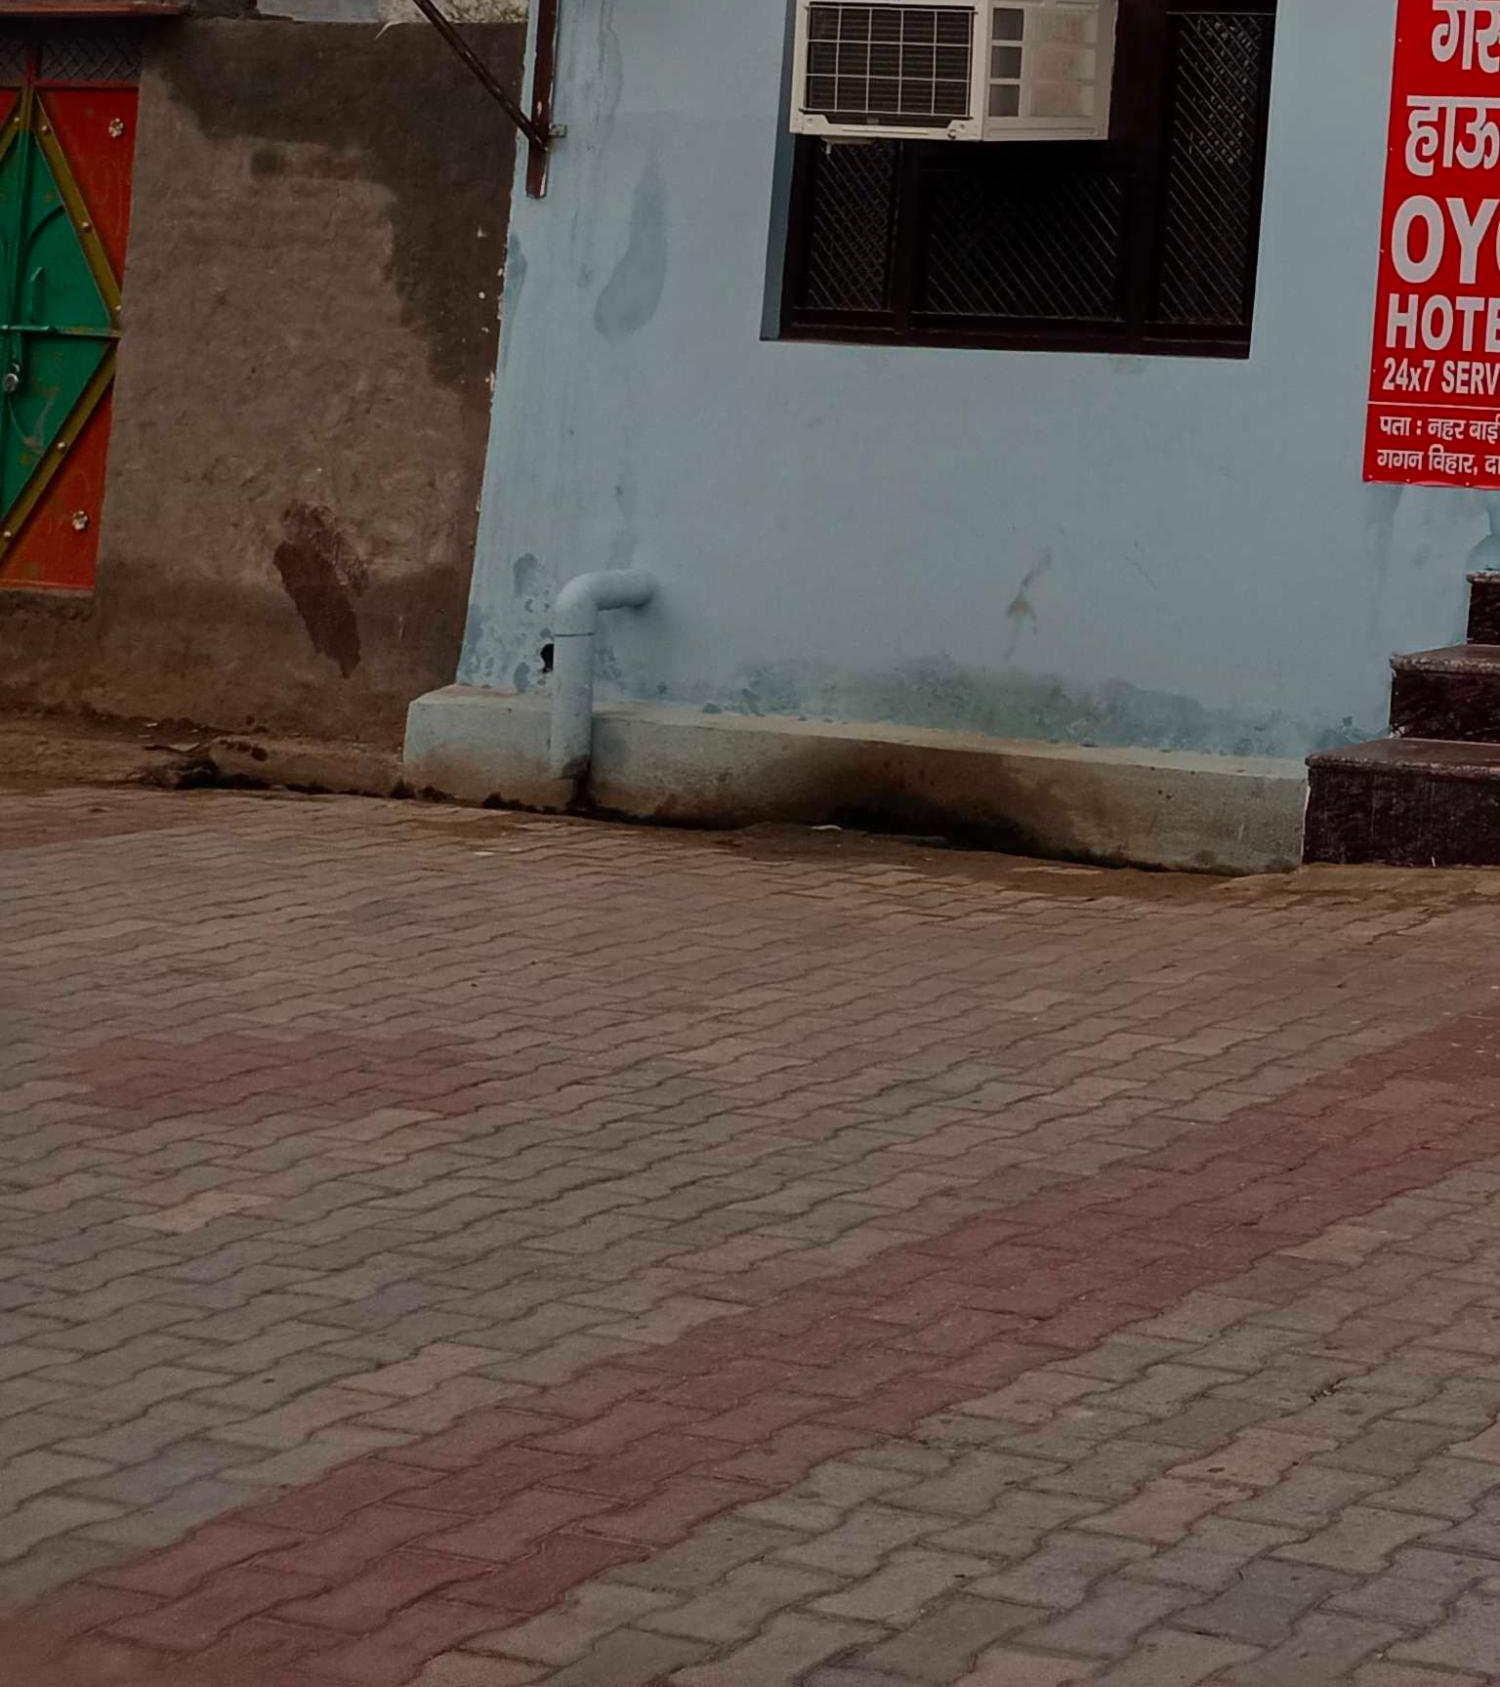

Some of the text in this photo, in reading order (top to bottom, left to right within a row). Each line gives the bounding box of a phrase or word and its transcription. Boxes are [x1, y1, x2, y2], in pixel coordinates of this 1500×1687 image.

[1382, 357, 1436, 391] 24x7
[1379, 415, 1412, 436] पता
[1427, 417, 1467, 441] नहर
[1377, 449, 1424, 471] गगन
[1428, 443, 1478, 475] विहार,
